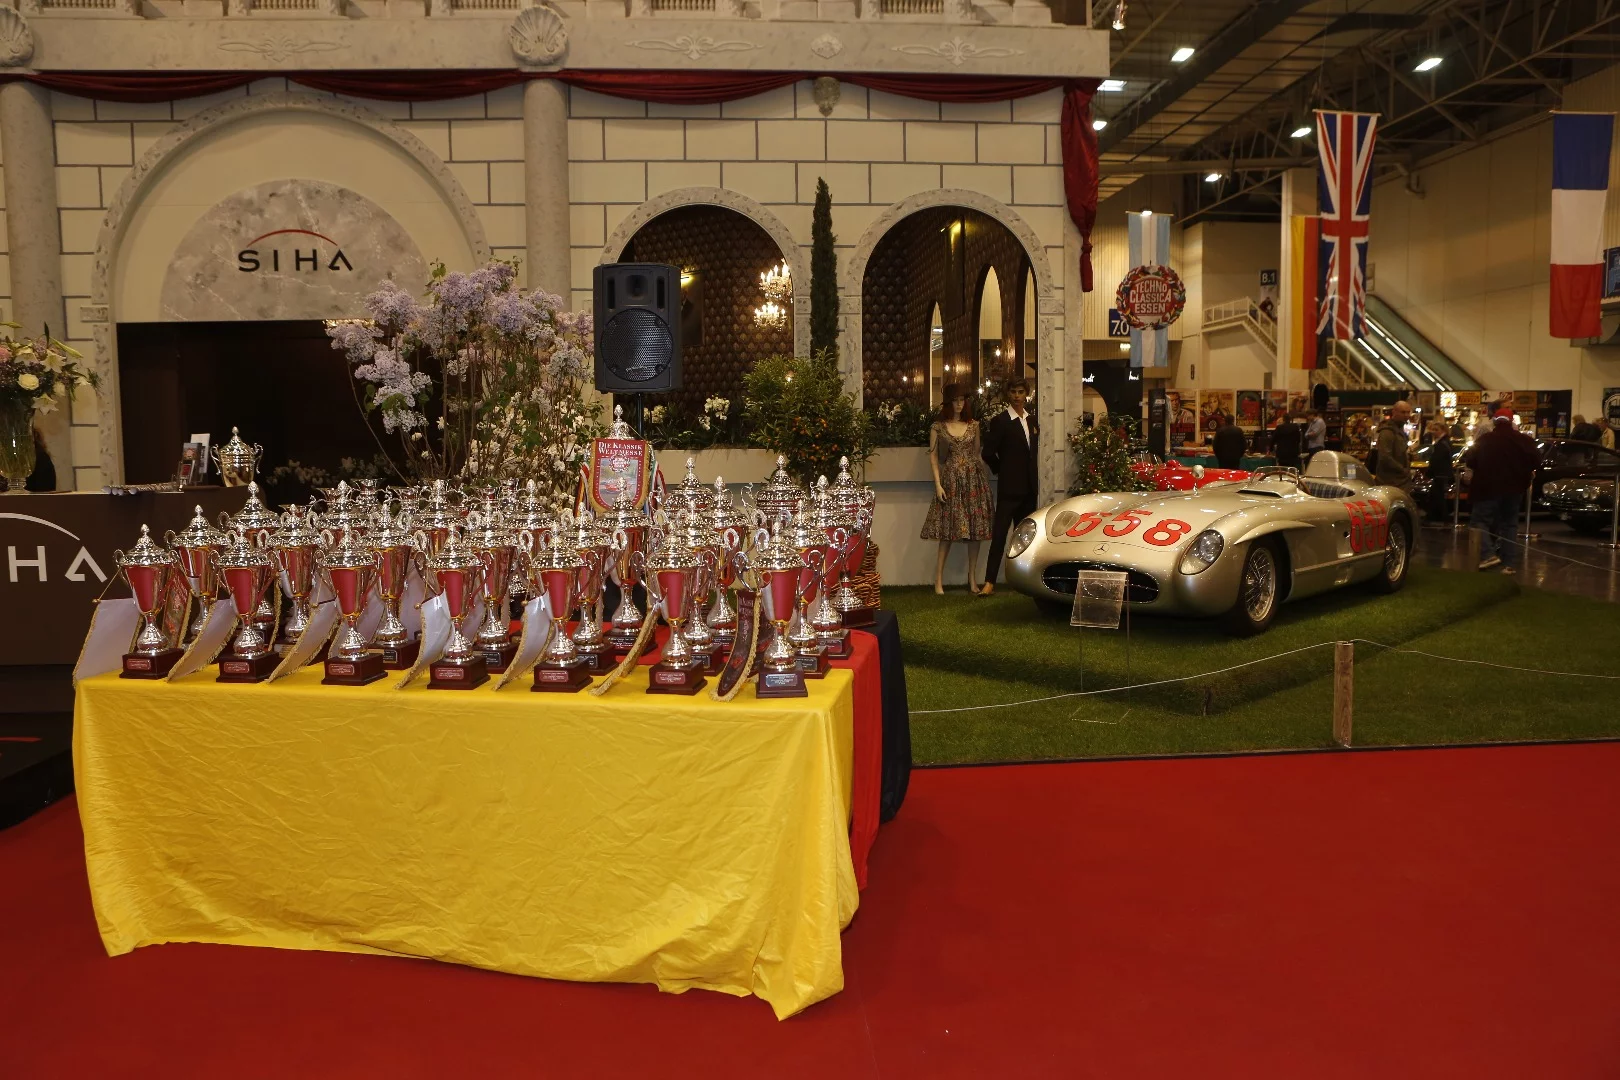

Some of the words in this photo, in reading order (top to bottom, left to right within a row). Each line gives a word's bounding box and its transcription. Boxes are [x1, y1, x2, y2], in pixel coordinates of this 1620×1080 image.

[238, 249, 353, 272] SIHA
[1136, 280, 1168, 293] TECHNO
[1129, 290, 1172, 303] CLASSICA
[1134, 303, 1166, 314] ESSEN
[1111, 319, 1129, 335] 7.0
[598, 441, 612, 449] DIE
[613, 442, 643, 450] KLASSIK
[1066, 510, 1191, 546] 658
[1344, 500, 1386, 553] 658
